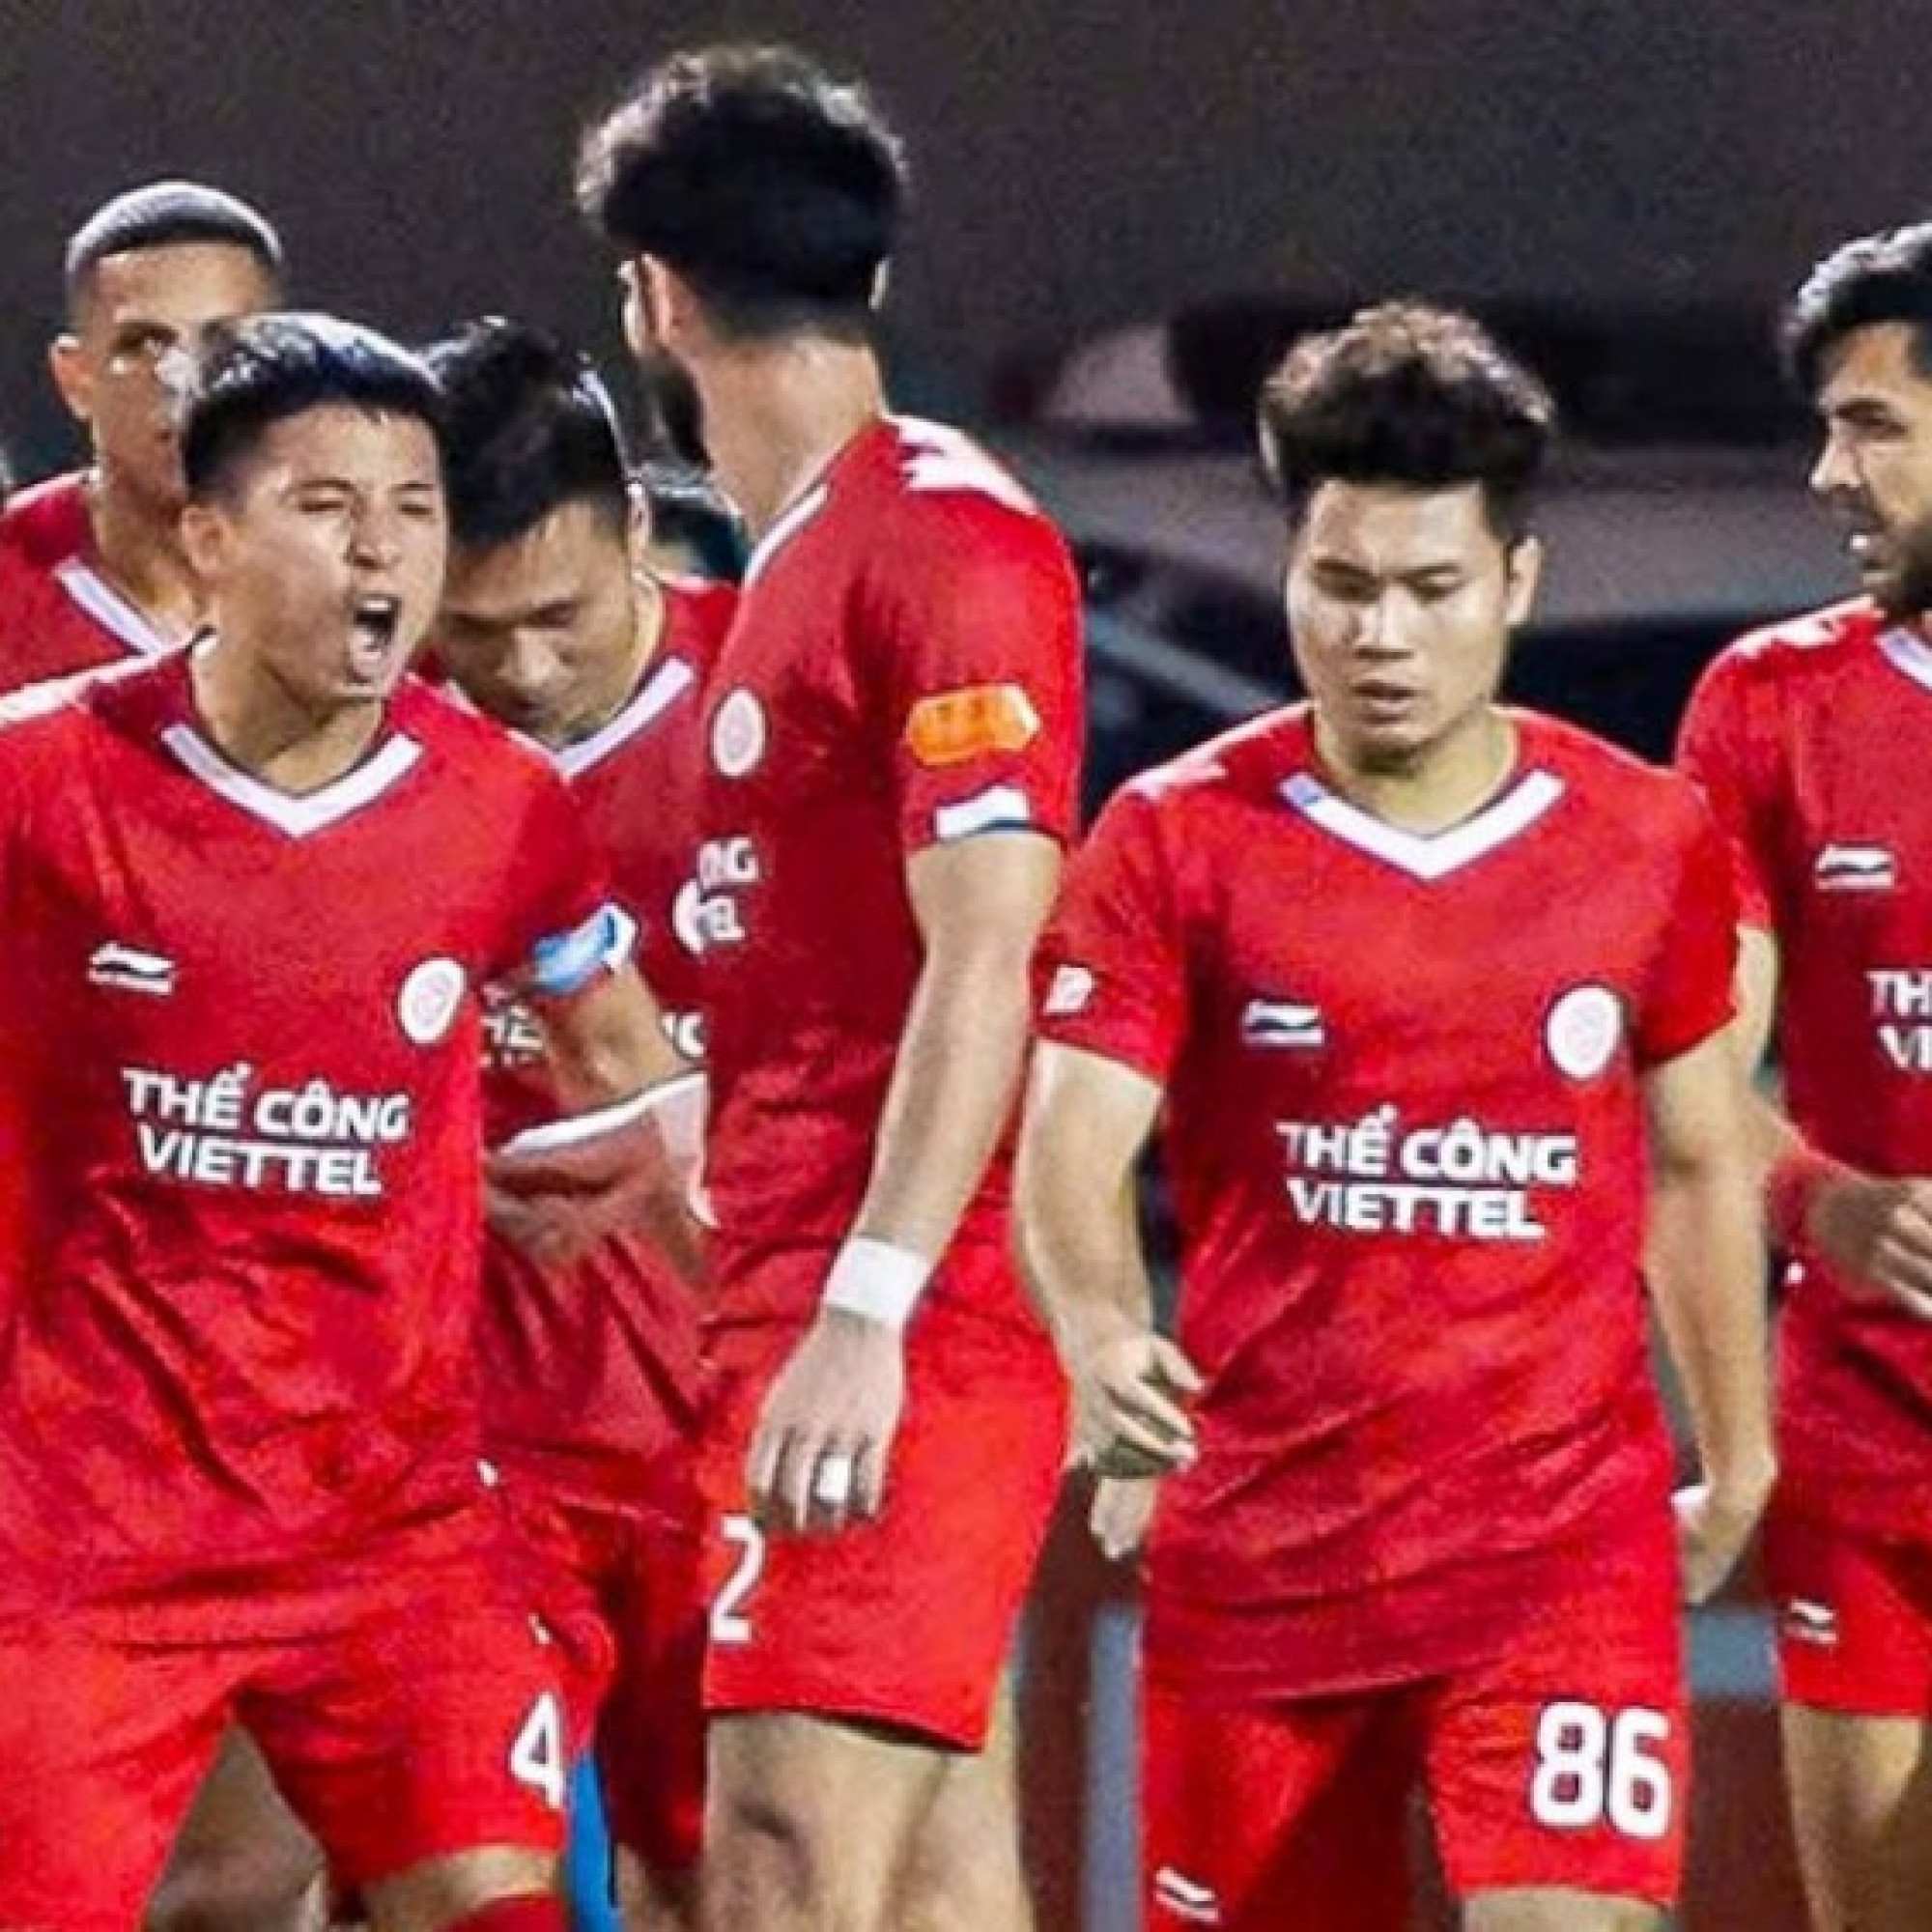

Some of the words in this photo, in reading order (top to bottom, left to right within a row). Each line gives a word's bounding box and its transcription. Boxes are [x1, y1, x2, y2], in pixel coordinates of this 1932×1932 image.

[256, 1079, 410, 1141] CÔNG
[137, 1124, 383, 1196] VIETTEL
[1402, 1118, 1578, 1182] CÔNG
[1287, 1179, 1546, 1238] VIETTEL
[709, 1515, 765, 1642] 2
[510, 1690, 566, 1809] 4
[1529, 1701, 1673, 1838] 86
